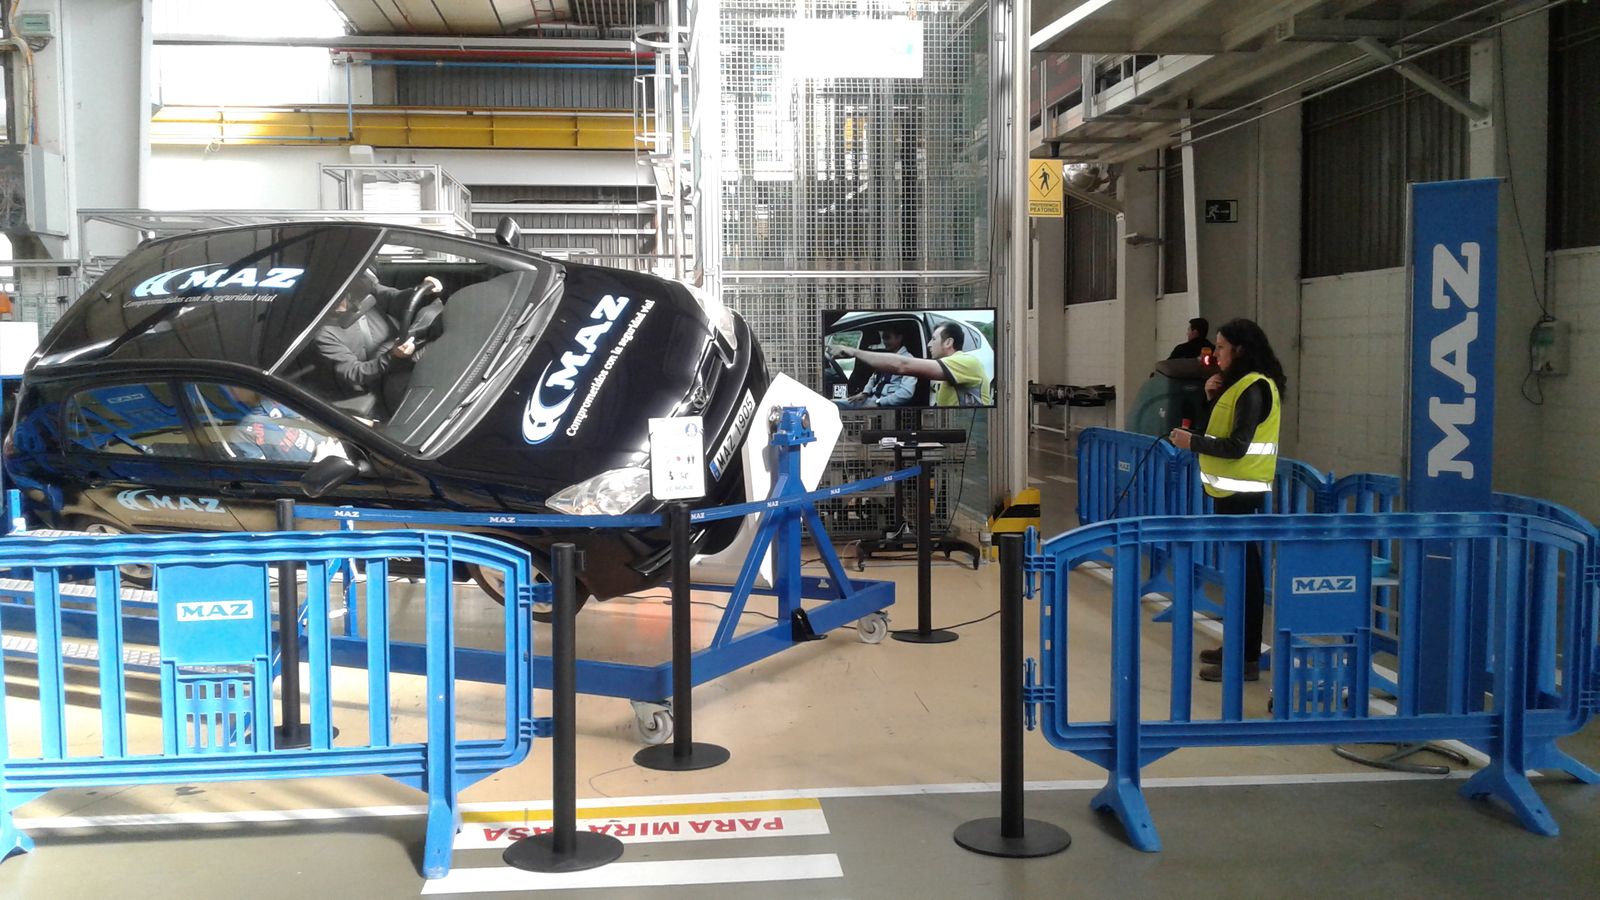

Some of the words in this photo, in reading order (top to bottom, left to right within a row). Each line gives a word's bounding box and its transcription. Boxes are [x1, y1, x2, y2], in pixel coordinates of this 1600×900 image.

[177, 267, 305, 290] MAZ
[122, 295, 185, 309] Comprometidos
[185, 295, 202, 303] con
[201, 294, 209, 302] la
[209, 293, 257, 303] seguridad
[257, 294, 278, 303] vial
[641, 299, 656, 314] vial
[618, 311, 647, 347] seguridad
[545, 294, 630, 390] MAZ
[610, 346, 624, 356] la
[604, 354, 619, 370] con
[1427, 241, 1480, 480] MAZ
[566, 369, 609, 437] Comprometidos
[717, 434, 736, 470] MAZ
[734, 395, 753, 436] 1905
[145, 494, 226, 514] MAZ
[766, 500, 779, 508] MAZ
[334, 510, 360, 518] MAZ
[489, 516, 516, 524] MAZ
[690, 512, 705, 520] MAZ
[1295, 578, 1353, 592] MAZ
[181, 603, 249, 618] MAZ
[588, 820, 680, 838] MIRA
[688, 816, 784, 834] PARA
[483, 825, 555, 842] ASA
